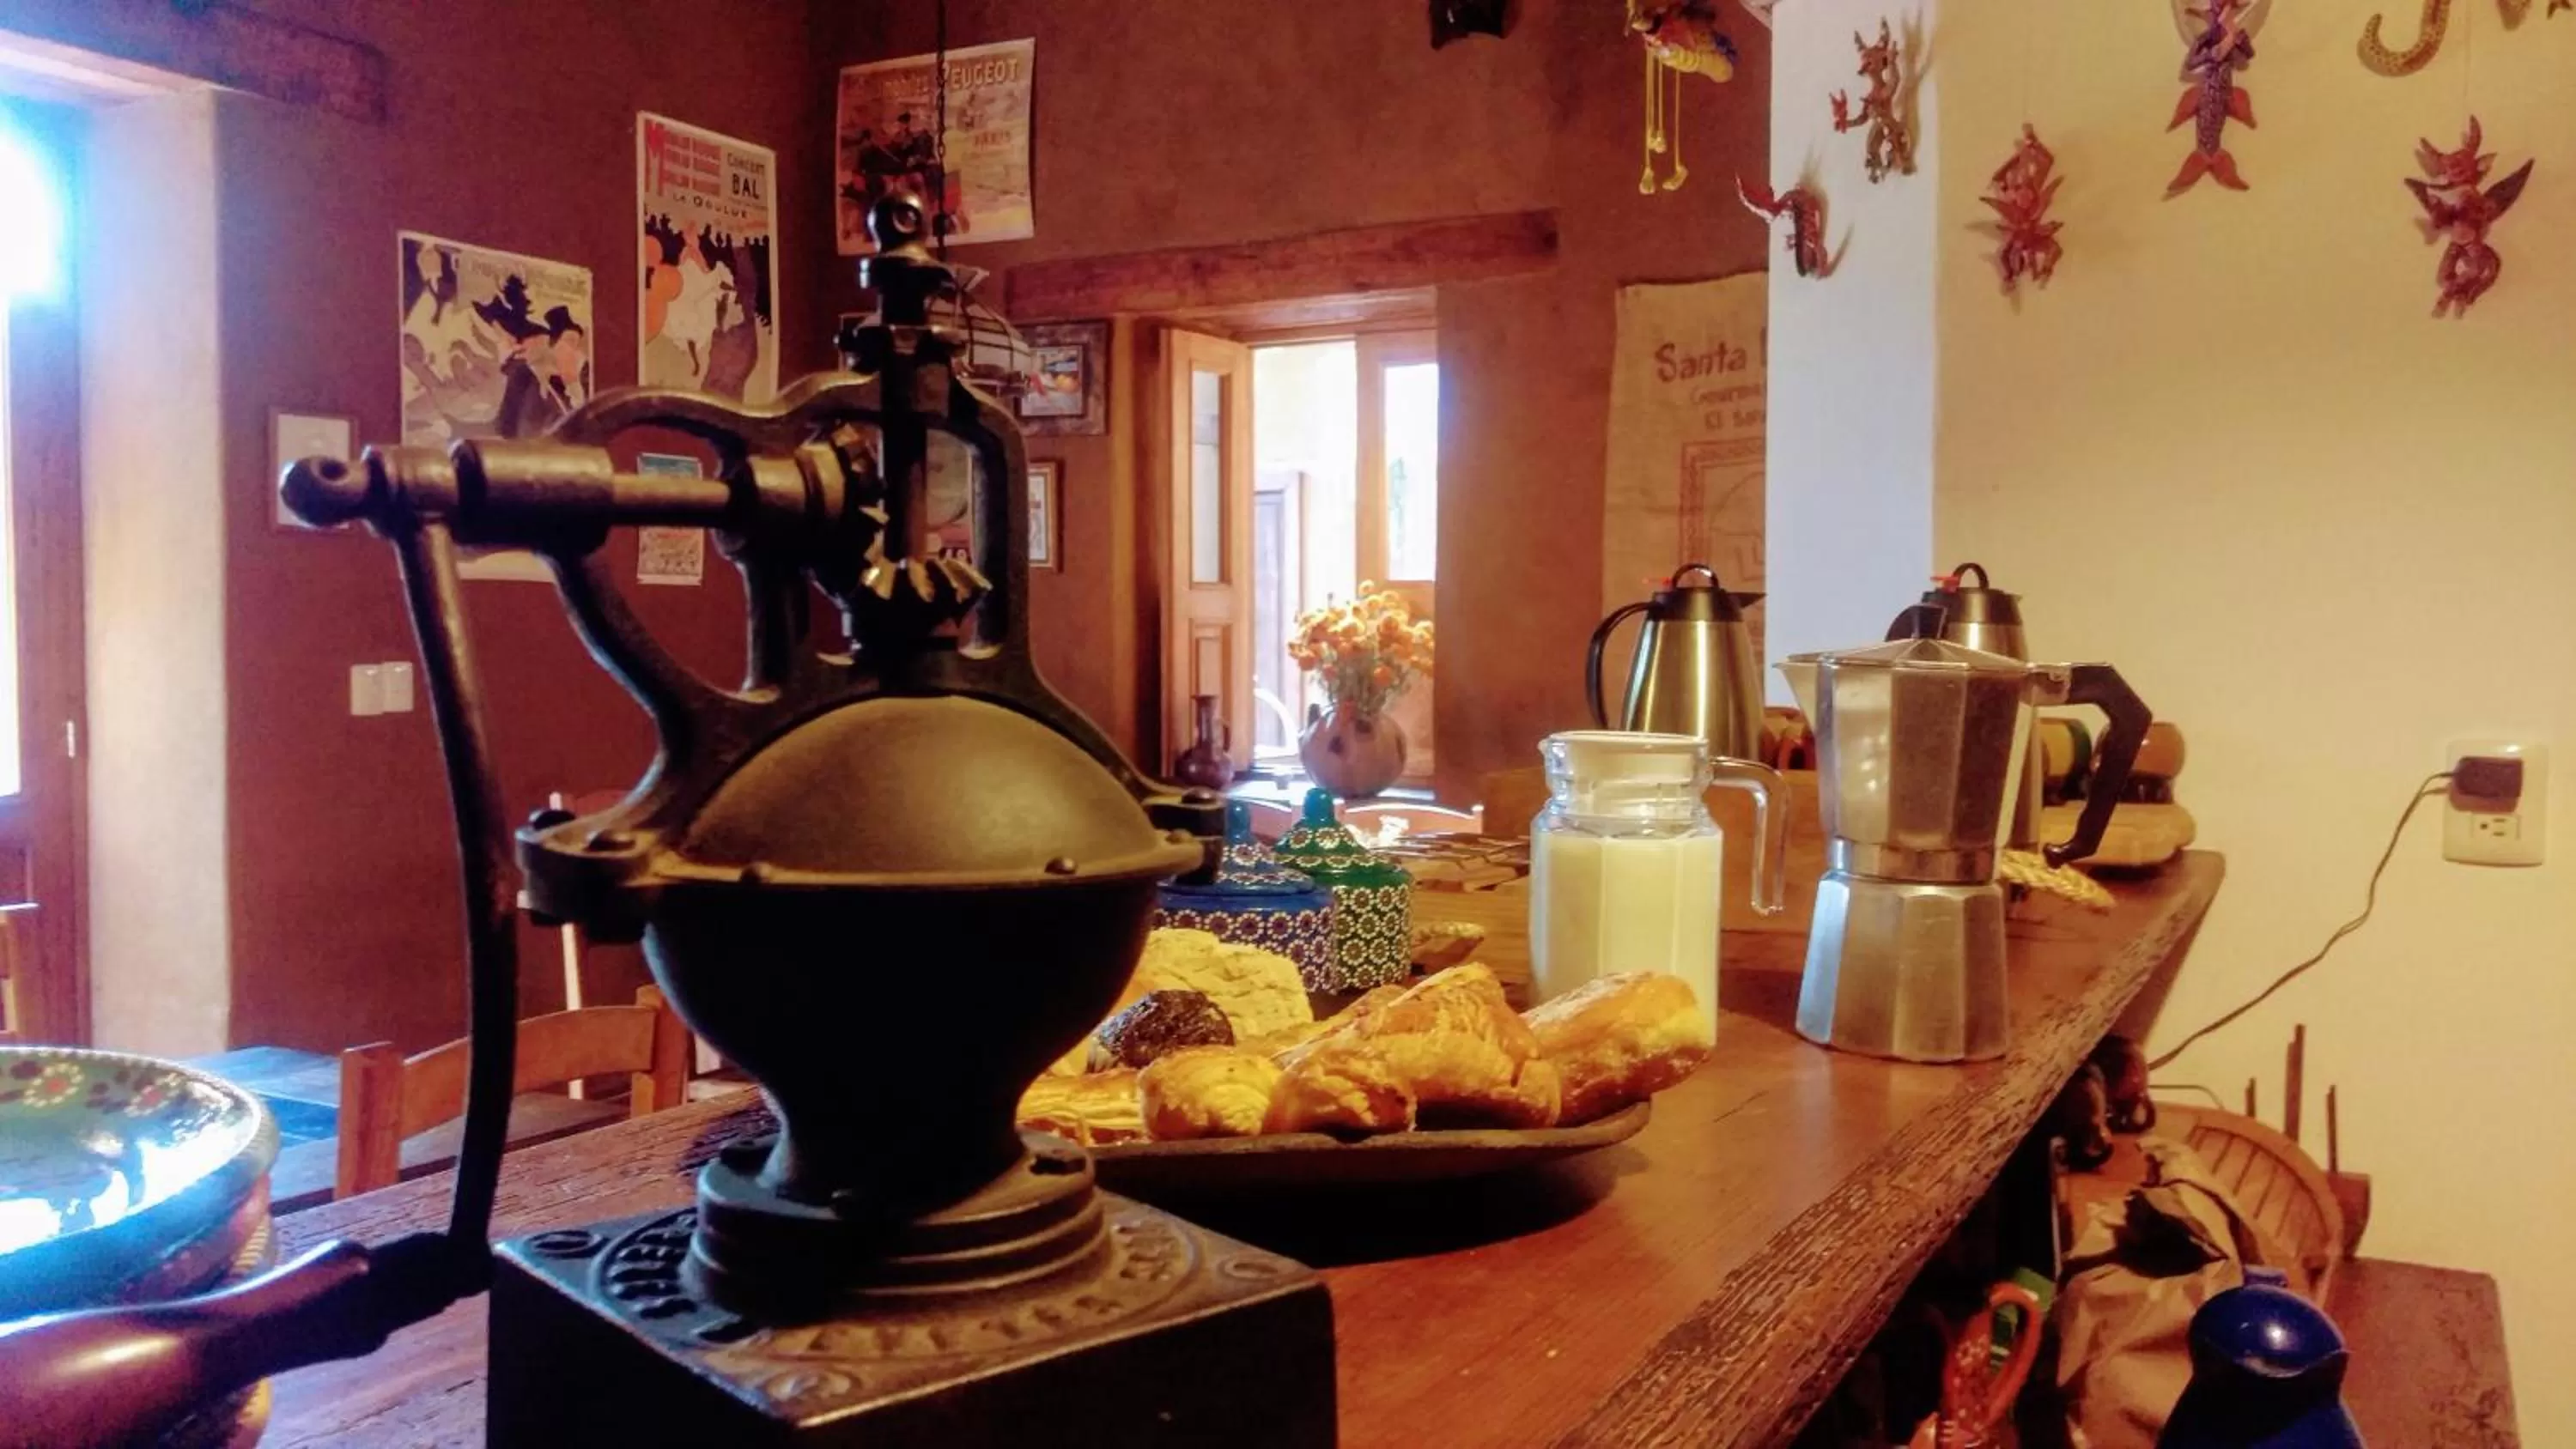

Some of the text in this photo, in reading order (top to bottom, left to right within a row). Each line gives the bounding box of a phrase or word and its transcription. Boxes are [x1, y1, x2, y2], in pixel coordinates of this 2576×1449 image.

[942, 58, 1018, 91] PEUGEOT
[732, 173, 760, 200] BAL
[1654, 340, 1747, 383] Santa
